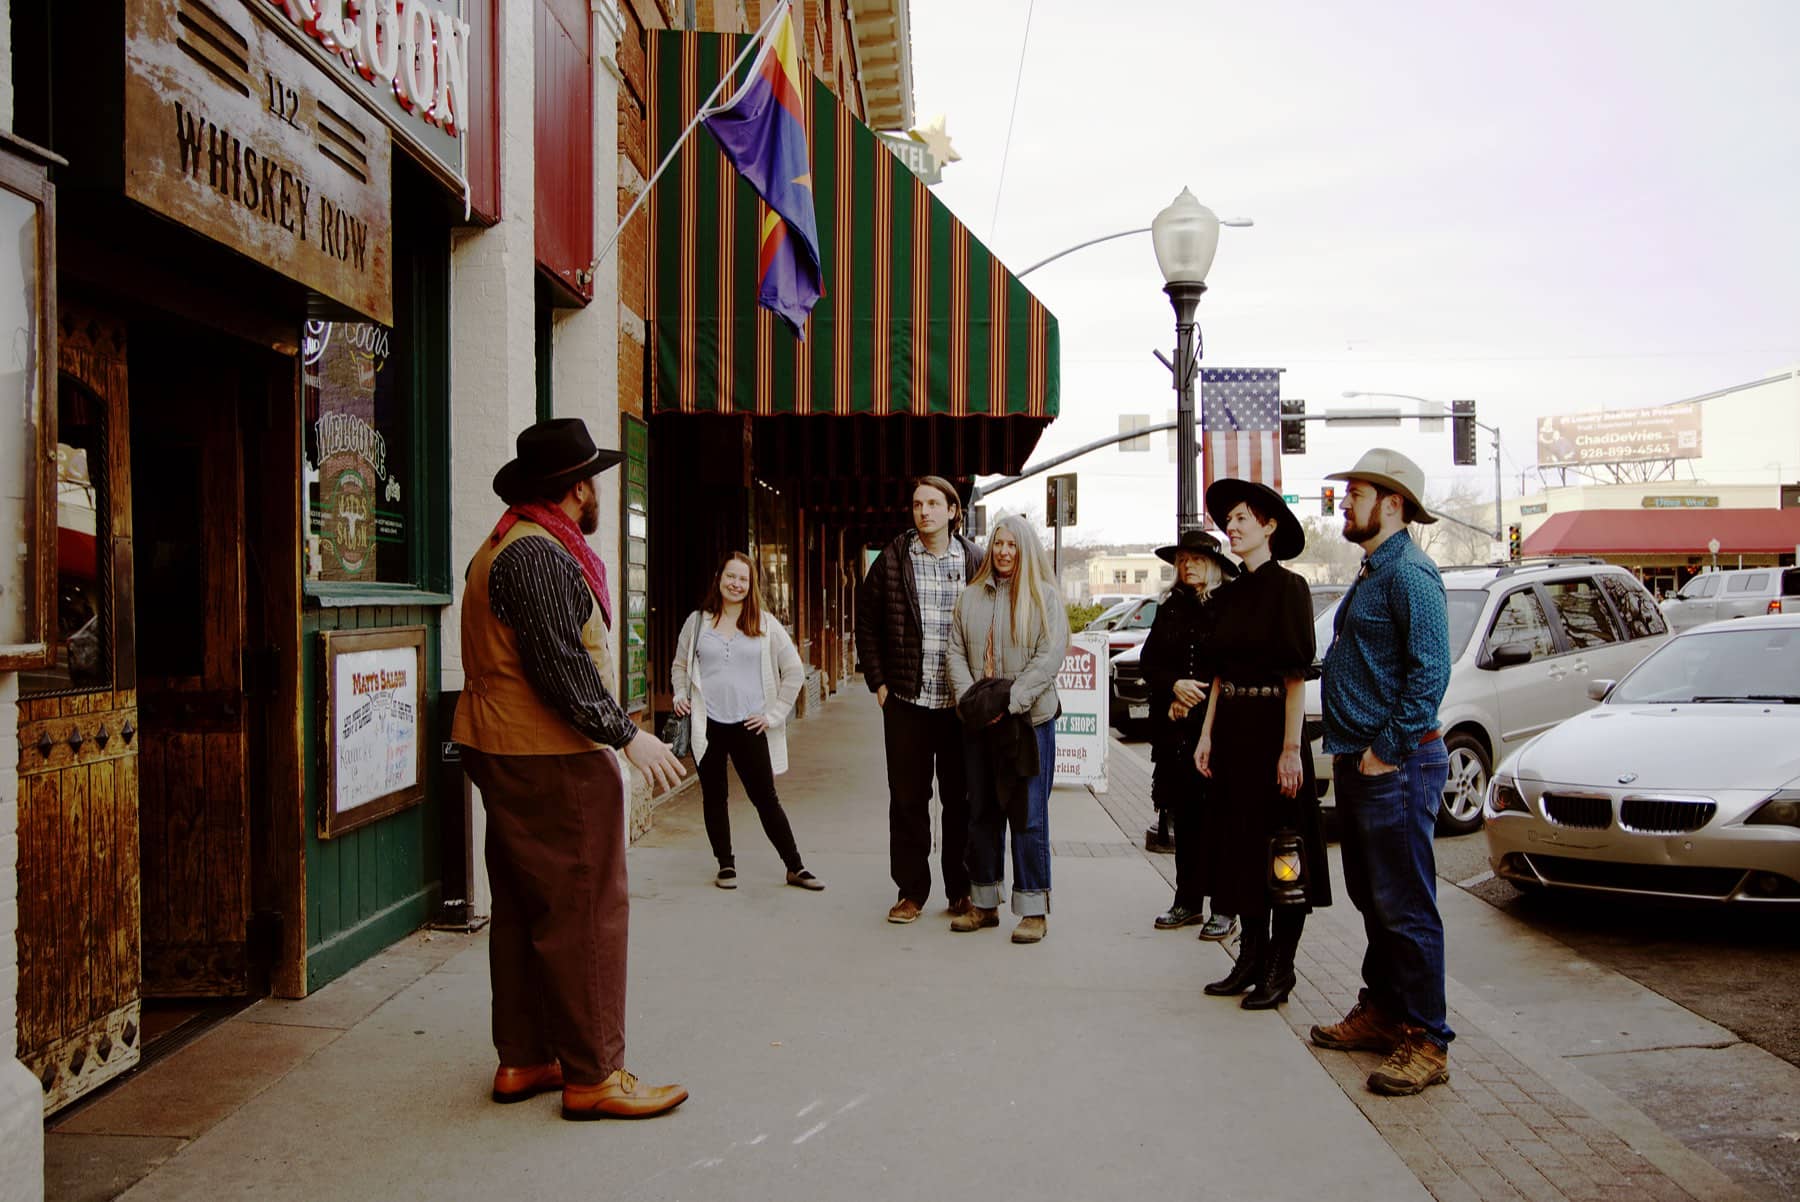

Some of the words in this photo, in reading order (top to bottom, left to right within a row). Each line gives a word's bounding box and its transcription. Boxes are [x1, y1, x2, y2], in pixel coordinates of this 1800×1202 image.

[266, 72, 301, 131] 112
[174, 100, 310, 241] WHISKEY
[320, 195, 367, 272] ROW
[344, 321, 390, 357] Coors
[314, 410, 387, 482] WELCOME
[1070, 717, 1096, 734] SHOPS
[1054, 762, 1081, 776] rking
